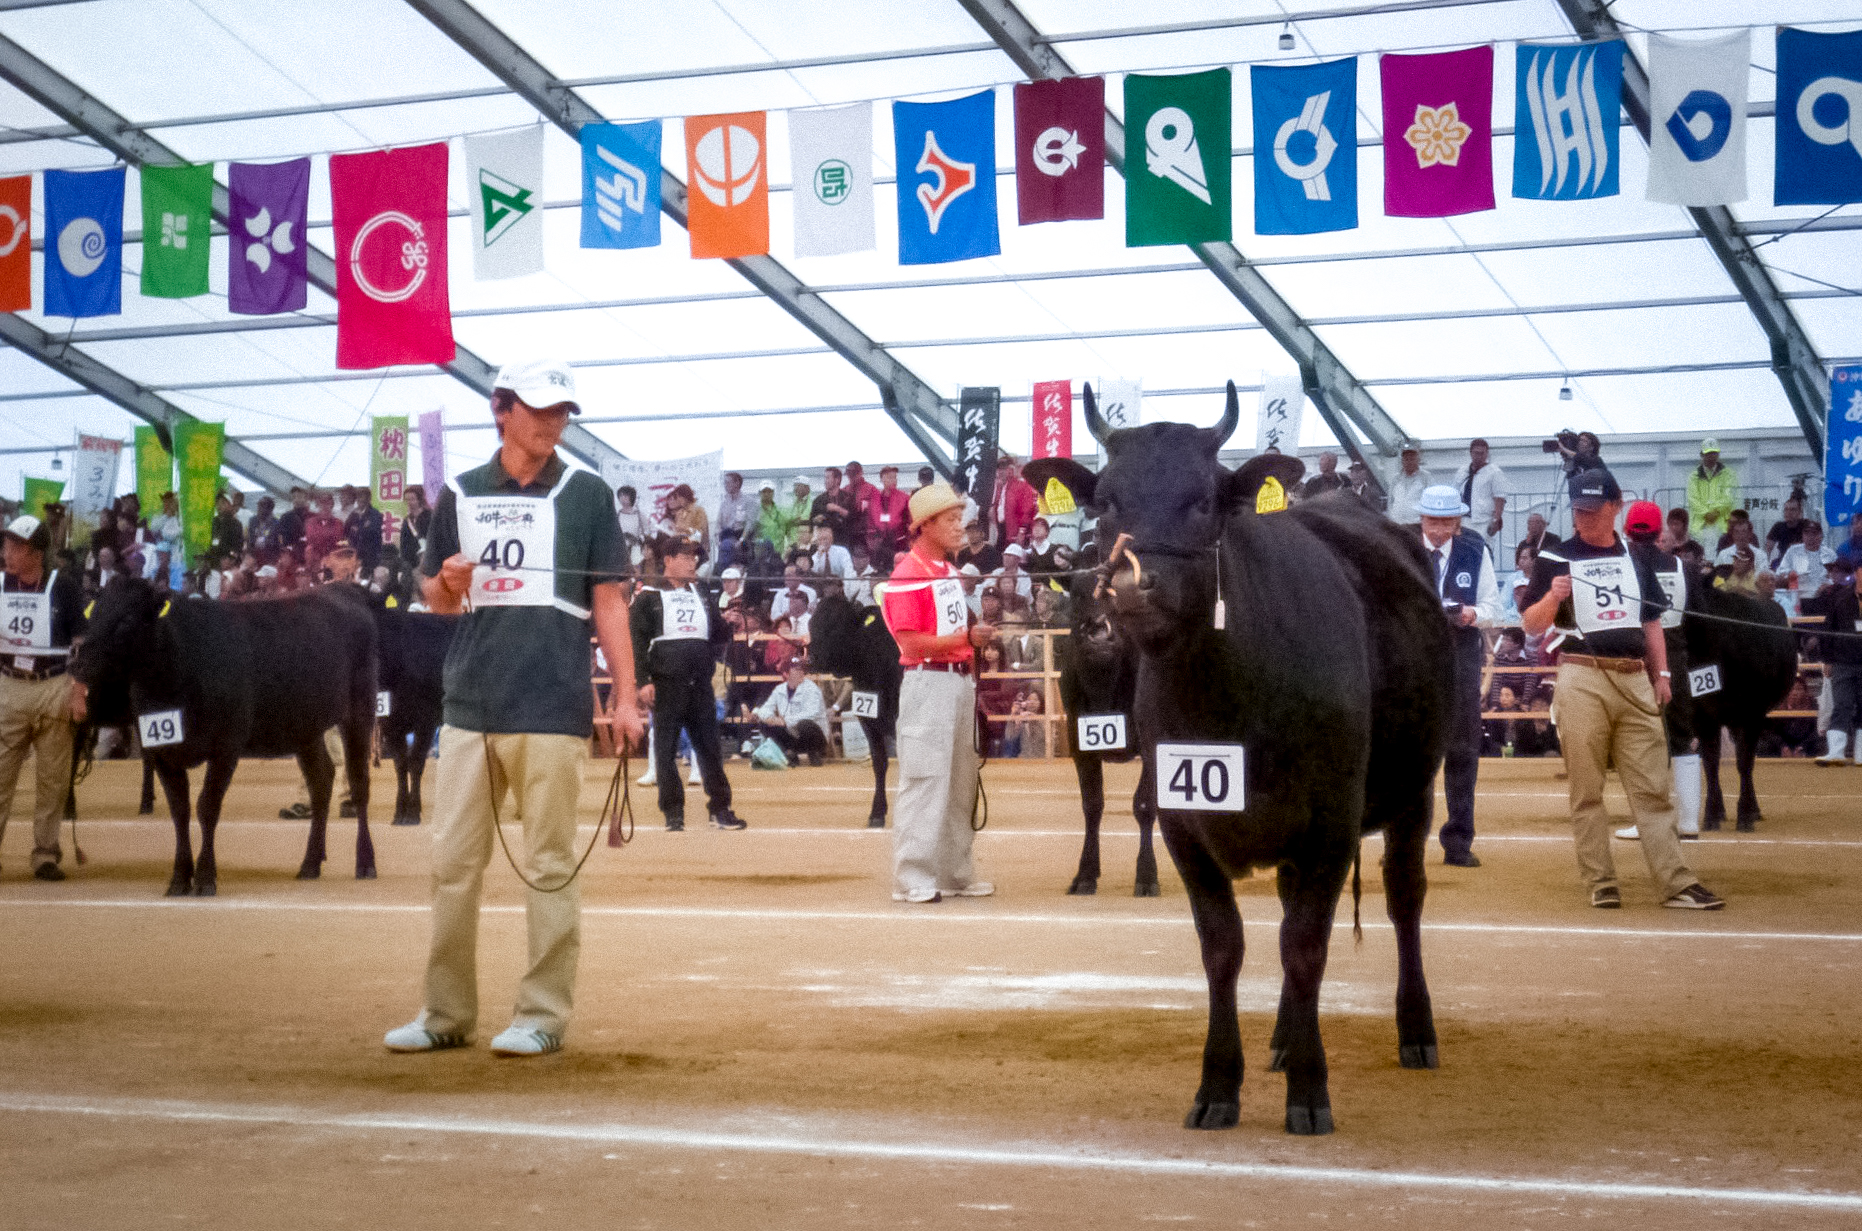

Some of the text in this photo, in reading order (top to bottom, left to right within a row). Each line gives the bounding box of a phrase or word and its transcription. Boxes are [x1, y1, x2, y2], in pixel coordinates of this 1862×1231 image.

[480, 538, 525, 571] 40
[1595, 584, 1624, 608] 51
[676, 608, 695, 623] 27
[947, 600, 964, 624] 50
[8, 616, 34, 635] 49
[1694, 672, 1716, 693] 28
[856, 696, 874, 714] 27
[146, 718, 176, 741] 49
[1086, 723, 1118, 746] 50
[1169, 758, 1230, 804] 40
